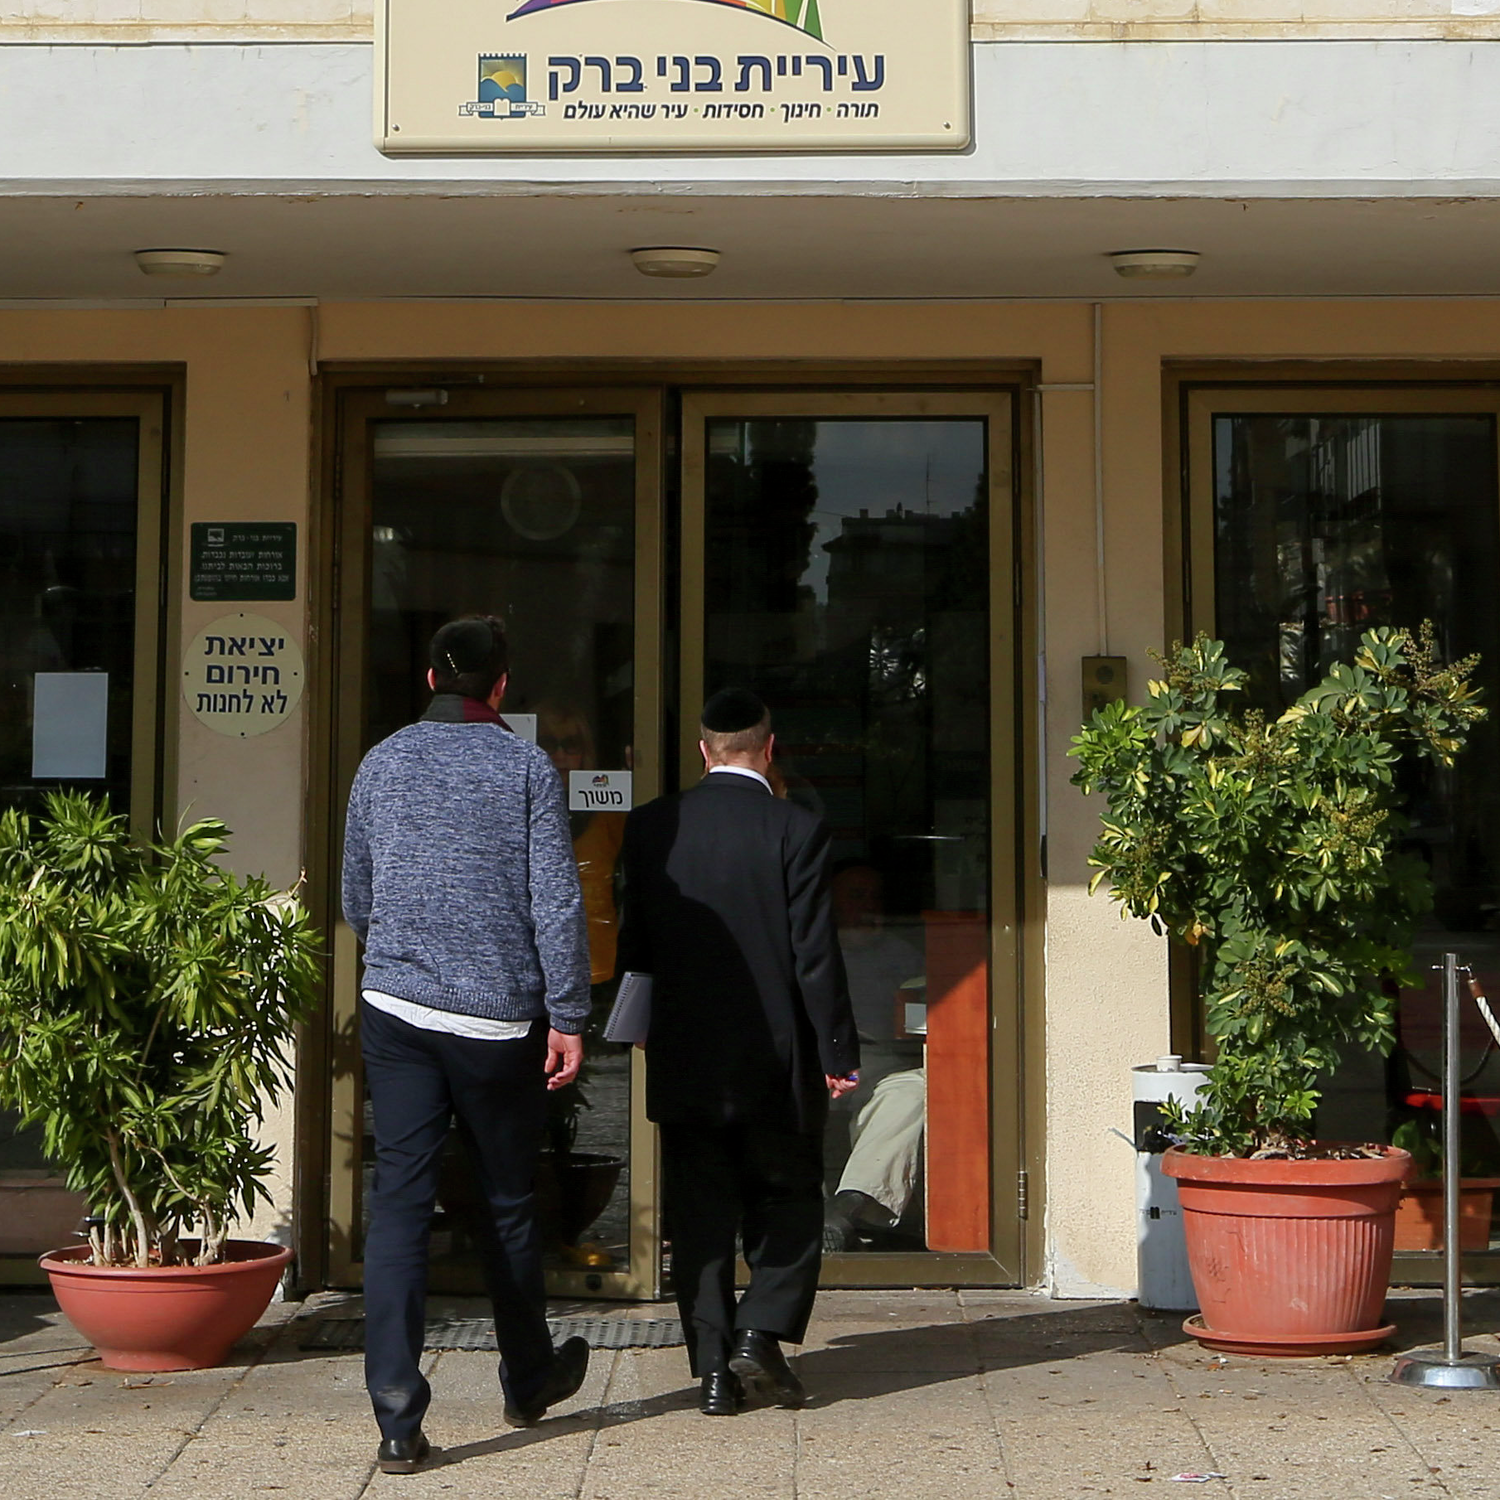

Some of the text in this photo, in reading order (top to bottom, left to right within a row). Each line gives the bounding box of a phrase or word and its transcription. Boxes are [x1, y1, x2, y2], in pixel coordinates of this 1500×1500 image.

[548, 55, 885, 101] עיריית בני ברק
[563, 100, 879, 123] תורה חינוך חסידות עיר שהיא עולם
[204, 636, 284, 656] יציאת
[206, 665, 280, 685] חירום
[196, 688, 287, 714] לא לחנות
[578, 790, 623, 808] משוך
